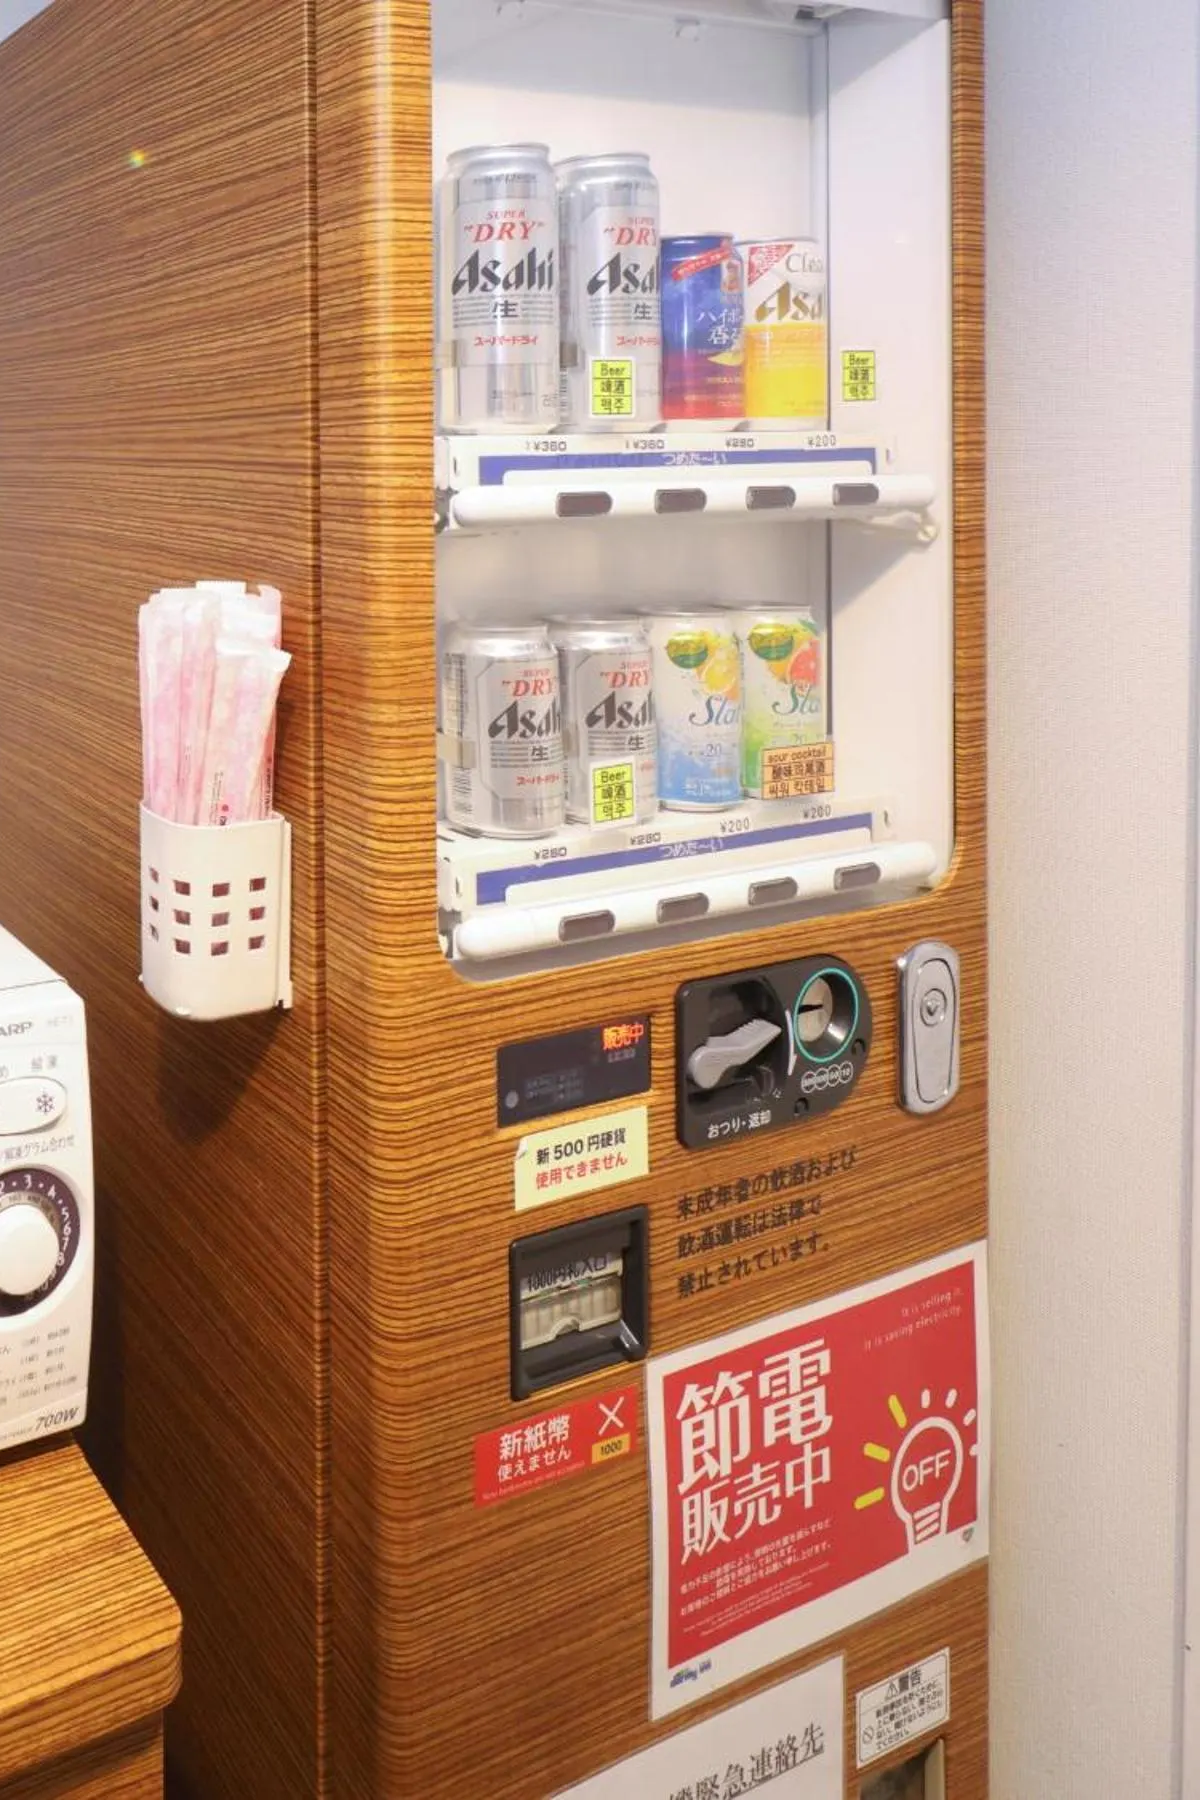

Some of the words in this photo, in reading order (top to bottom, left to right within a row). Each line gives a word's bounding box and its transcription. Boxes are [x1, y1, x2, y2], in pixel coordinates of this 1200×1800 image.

[486, 209, 526, 220] SUPER
[451, 248, 554, 295] Asahi
[587, 252, 659, 297] Asa
[492, 300, 519, 319] 生
[755, 281, 823, 322] Asa
[633, 302, 654, 320] 生
[474, 335, 538, 347] スーパードライ
[849, 354, 870, 366] Beer
[600, 363, 626, 377] Beer
[808, 435, 836, 447] ¥200
[628, 734, 644, 751] 生
[531, 746, 549, 762] 生
[601, 770, 626, 783] Beer
[803, 805, 832, 819] ¥200
[719, 817, 751, 832] ¥200
[708, 1110, 772, 1138] おつり・返却
[536, 1151, 628, 1190] 使用できません
[24, 1174, 32, 1189] 3
[678, 1144, 857, 1220] 未成年者の飲酒および
[48, 1184, 56, 1199] 4
[61, 1207, 69, 1221] 5
[63, 1221, 71, 1236] 6
[678, 1194, 822, 1259] 飲酒運転は法律で
[62, 1236, 70, 1251] 7
[678, 1231, 829, 1298] 禁止されています。
[36, 1406, 80, 1431] 700W
[676, 1337, 833, 1495] 節電
[499, 1413, 570, 1460] 新紙幣
[600, 1439, 623, 1456] 1000
[497, 1445, 572, 1482] 使えません
[903, 1449, 951, 1492] OFF
[680, 1442, 832, 1566] 販売中
